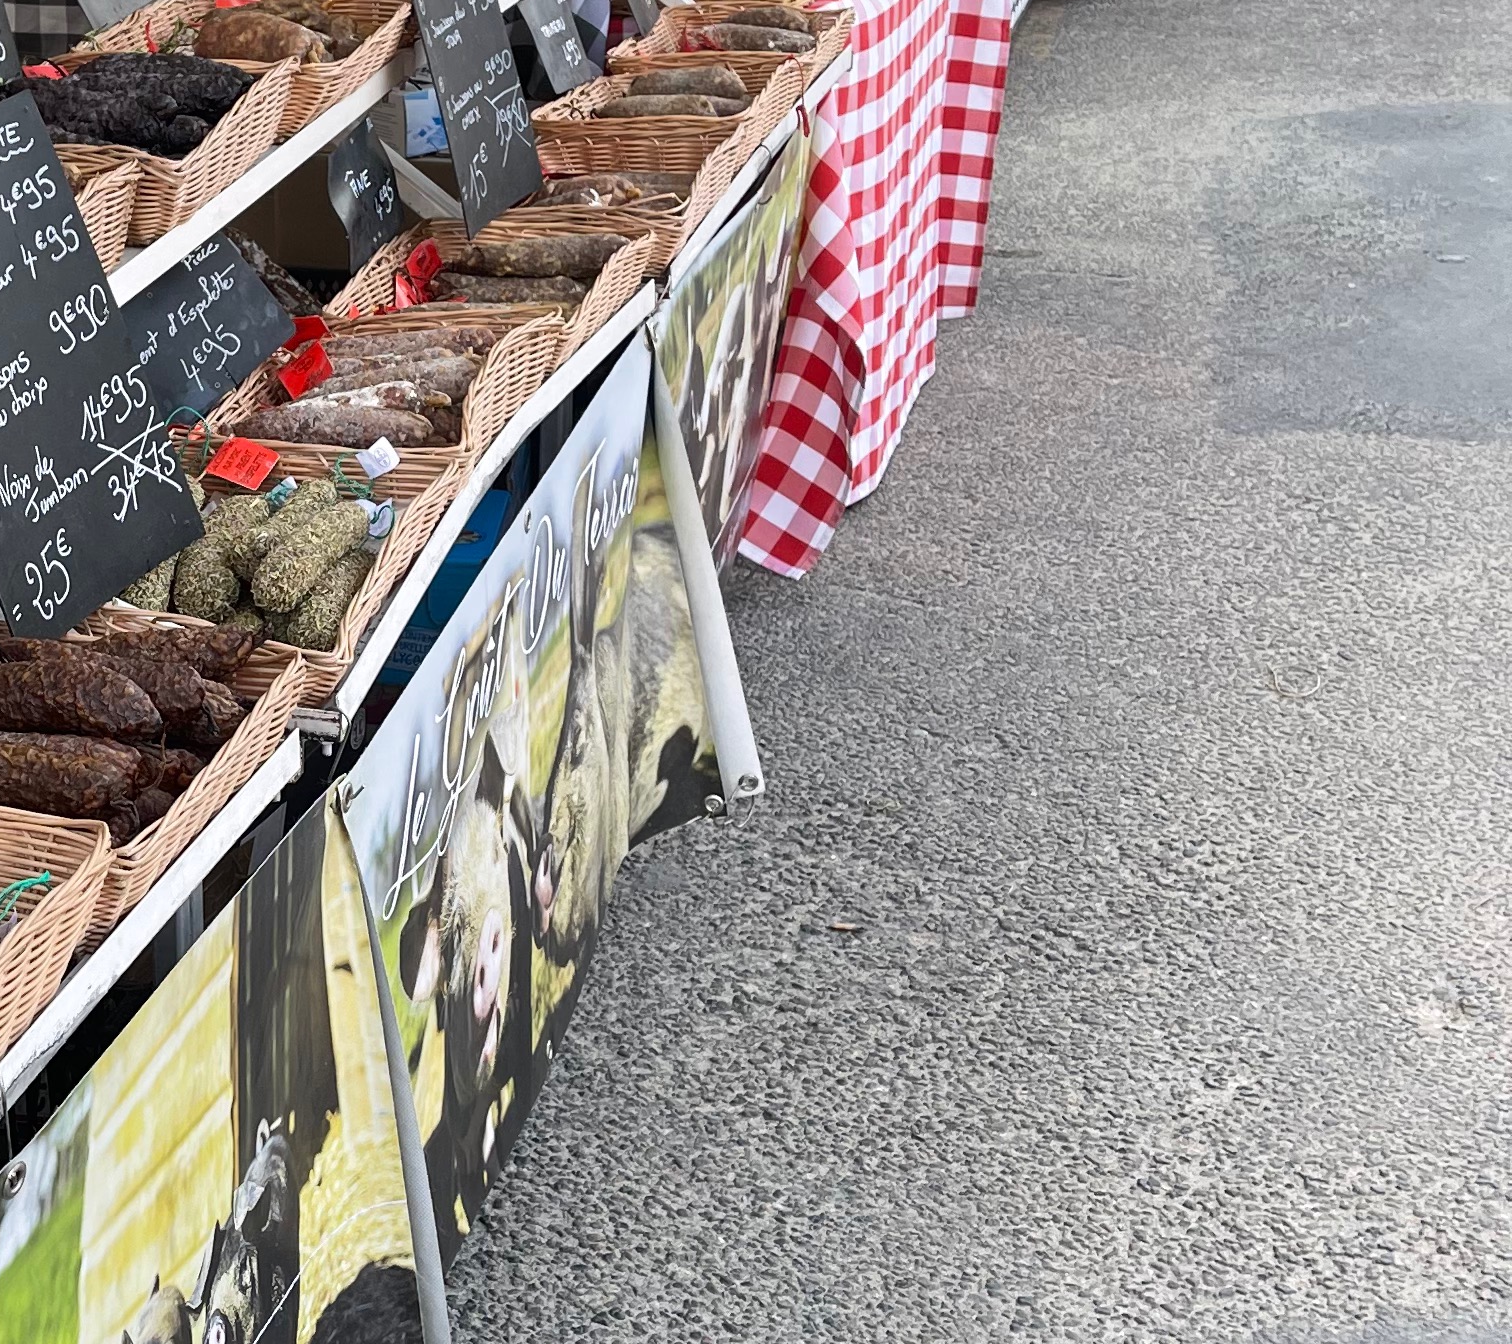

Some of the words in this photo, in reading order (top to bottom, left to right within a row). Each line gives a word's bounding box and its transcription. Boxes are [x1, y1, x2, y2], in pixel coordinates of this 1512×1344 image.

[0, 164, 56, 224] 4€95
[20, 214, 80, 280] 4€95
[180, 323, 241, 392] 4€95
[9, 376, 48, 417] choix
[25, 528, 72, 620] 25€
[383, 733, 434, 921] Le
